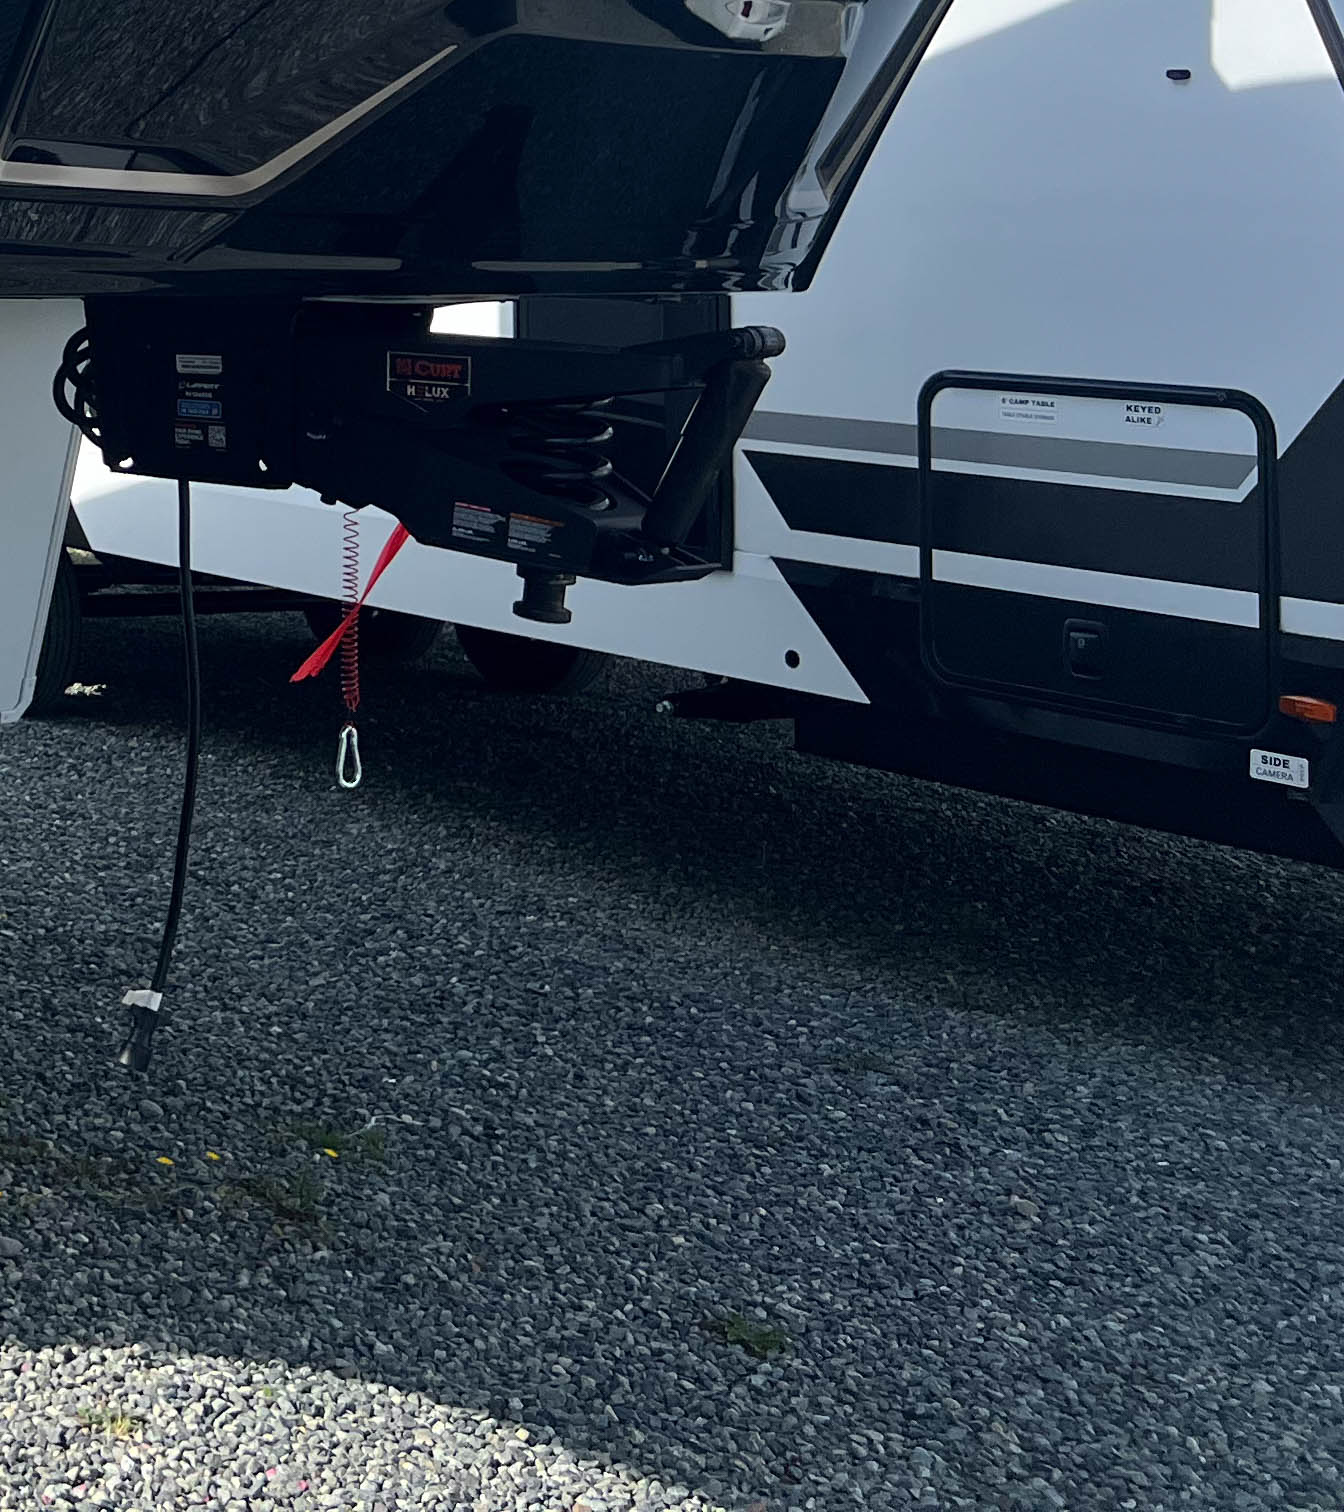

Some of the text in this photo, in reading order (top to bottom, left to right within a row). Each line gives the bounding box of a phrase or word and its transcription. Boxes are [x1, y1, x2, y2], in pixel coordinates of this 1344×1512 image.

[1126, 404, 1161, 414] KEYED
[1125, 416, 1152, 424] ALIKE
[1261, 755, 1290, 769] SIDE
[1256, 767, 1294, 781] CAMERA
